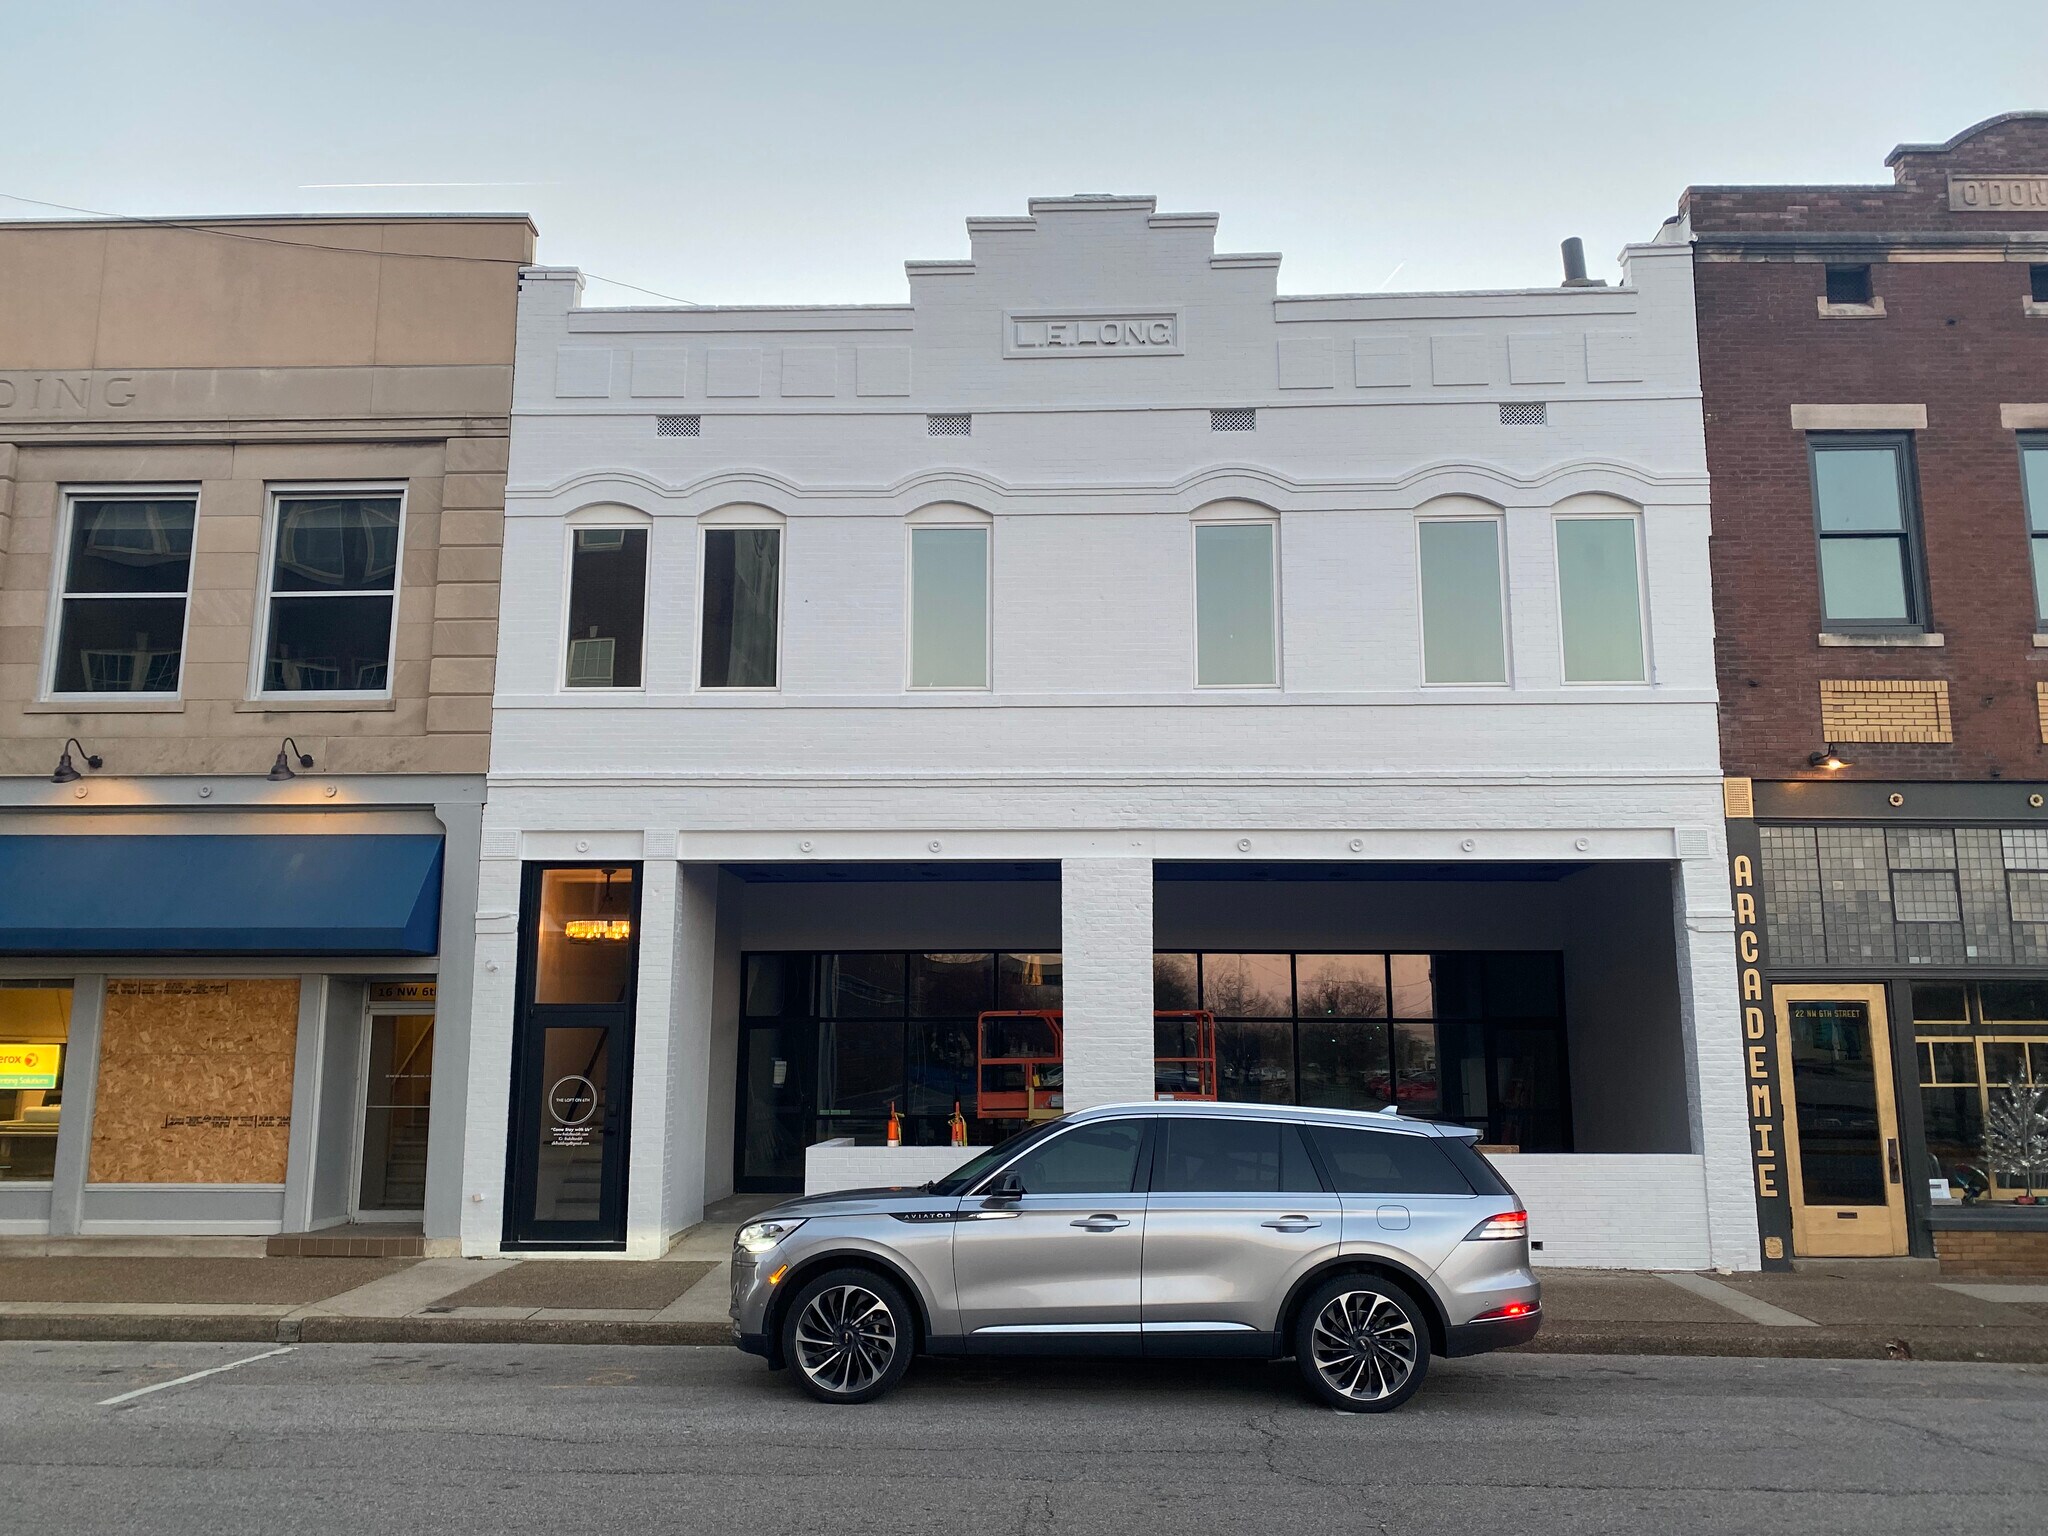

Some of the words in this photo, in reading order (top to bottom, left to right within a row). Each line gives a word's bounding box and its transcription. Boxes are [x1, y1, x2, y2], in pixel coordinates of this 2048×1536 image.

[379, 987, 393, 997] 16
[397, 987, 418, 996] NW
[422, 987, 436, 996] 6t
[1795, 1009, 1804, 1018] 22
[1806, 1009, 1817, 1018] NW
[1819, 1009, 1832, 1018] 6TH
[1834, 1009, 1860, 1018] STREET
[1734, 855, 1778, 1198] ARCADEMIE
